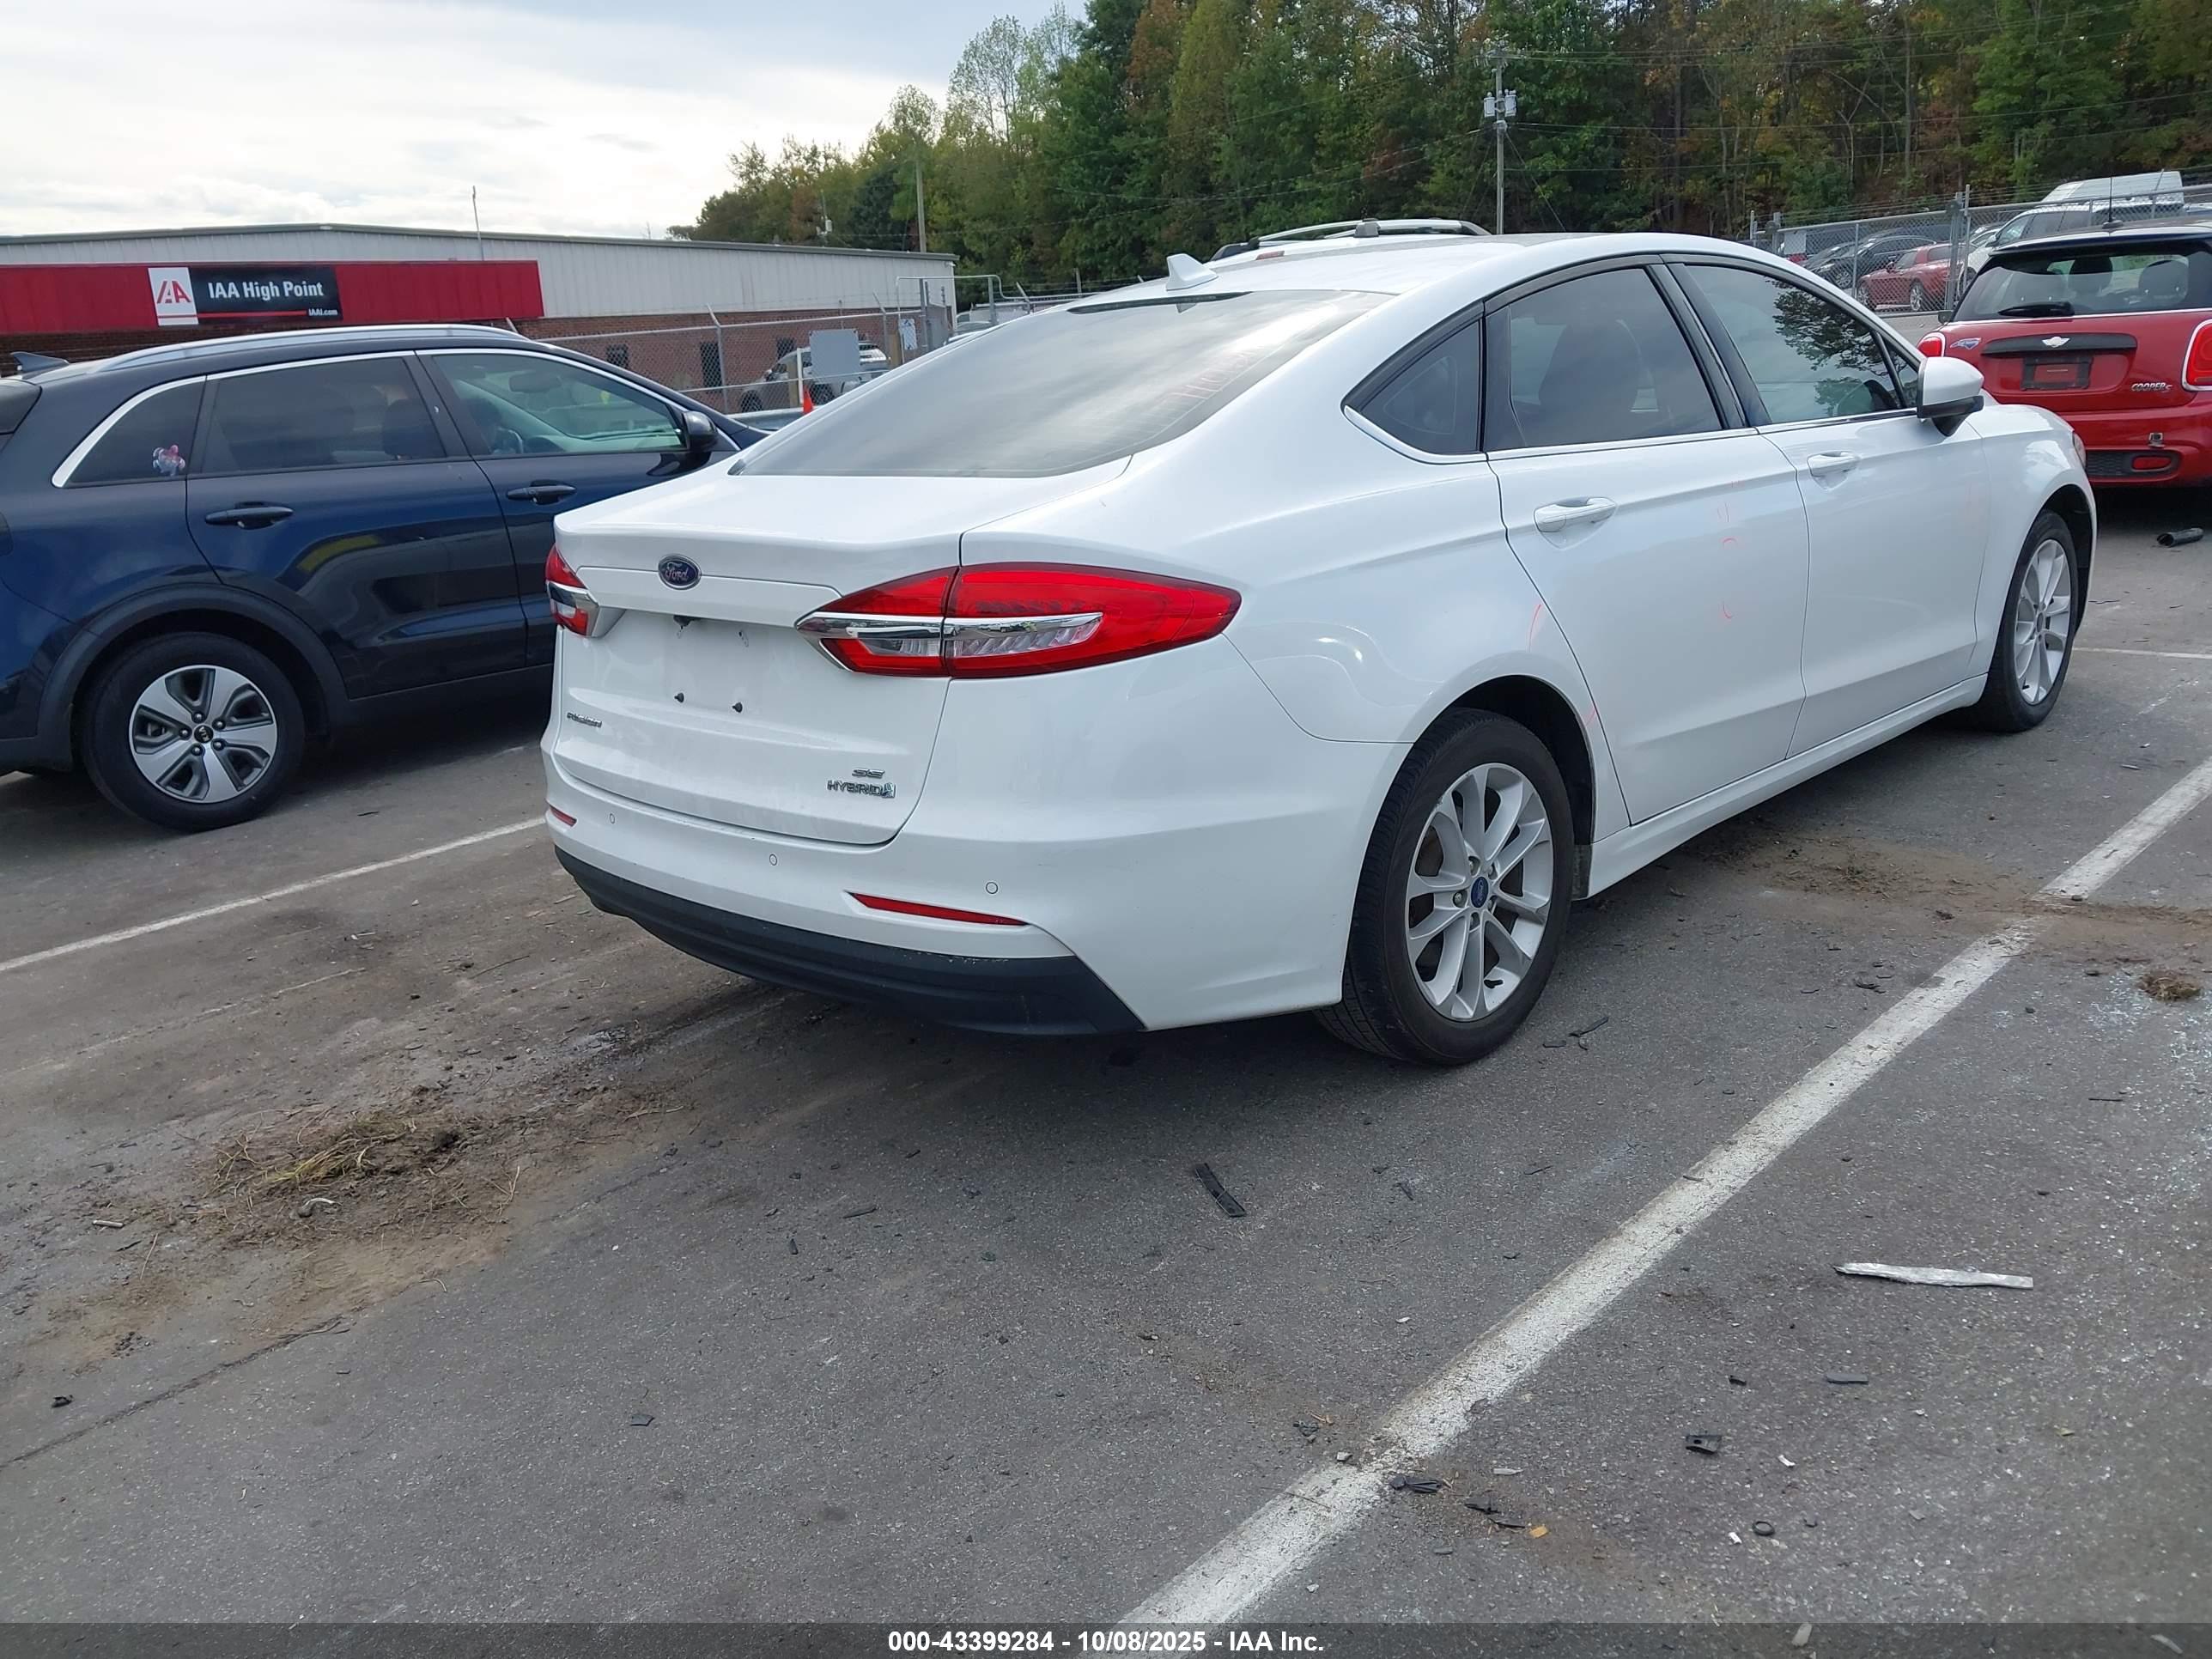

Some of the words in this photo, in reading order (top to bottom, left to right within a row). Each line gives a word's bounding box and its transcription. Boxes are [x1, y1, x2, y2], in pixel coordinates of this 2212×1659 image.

[208, 282, 240, 299] IAA
[243, 282, 280, 301] High
[283, 280, 324, 297] Point
[827, 780, 883, 797] HYBRID
